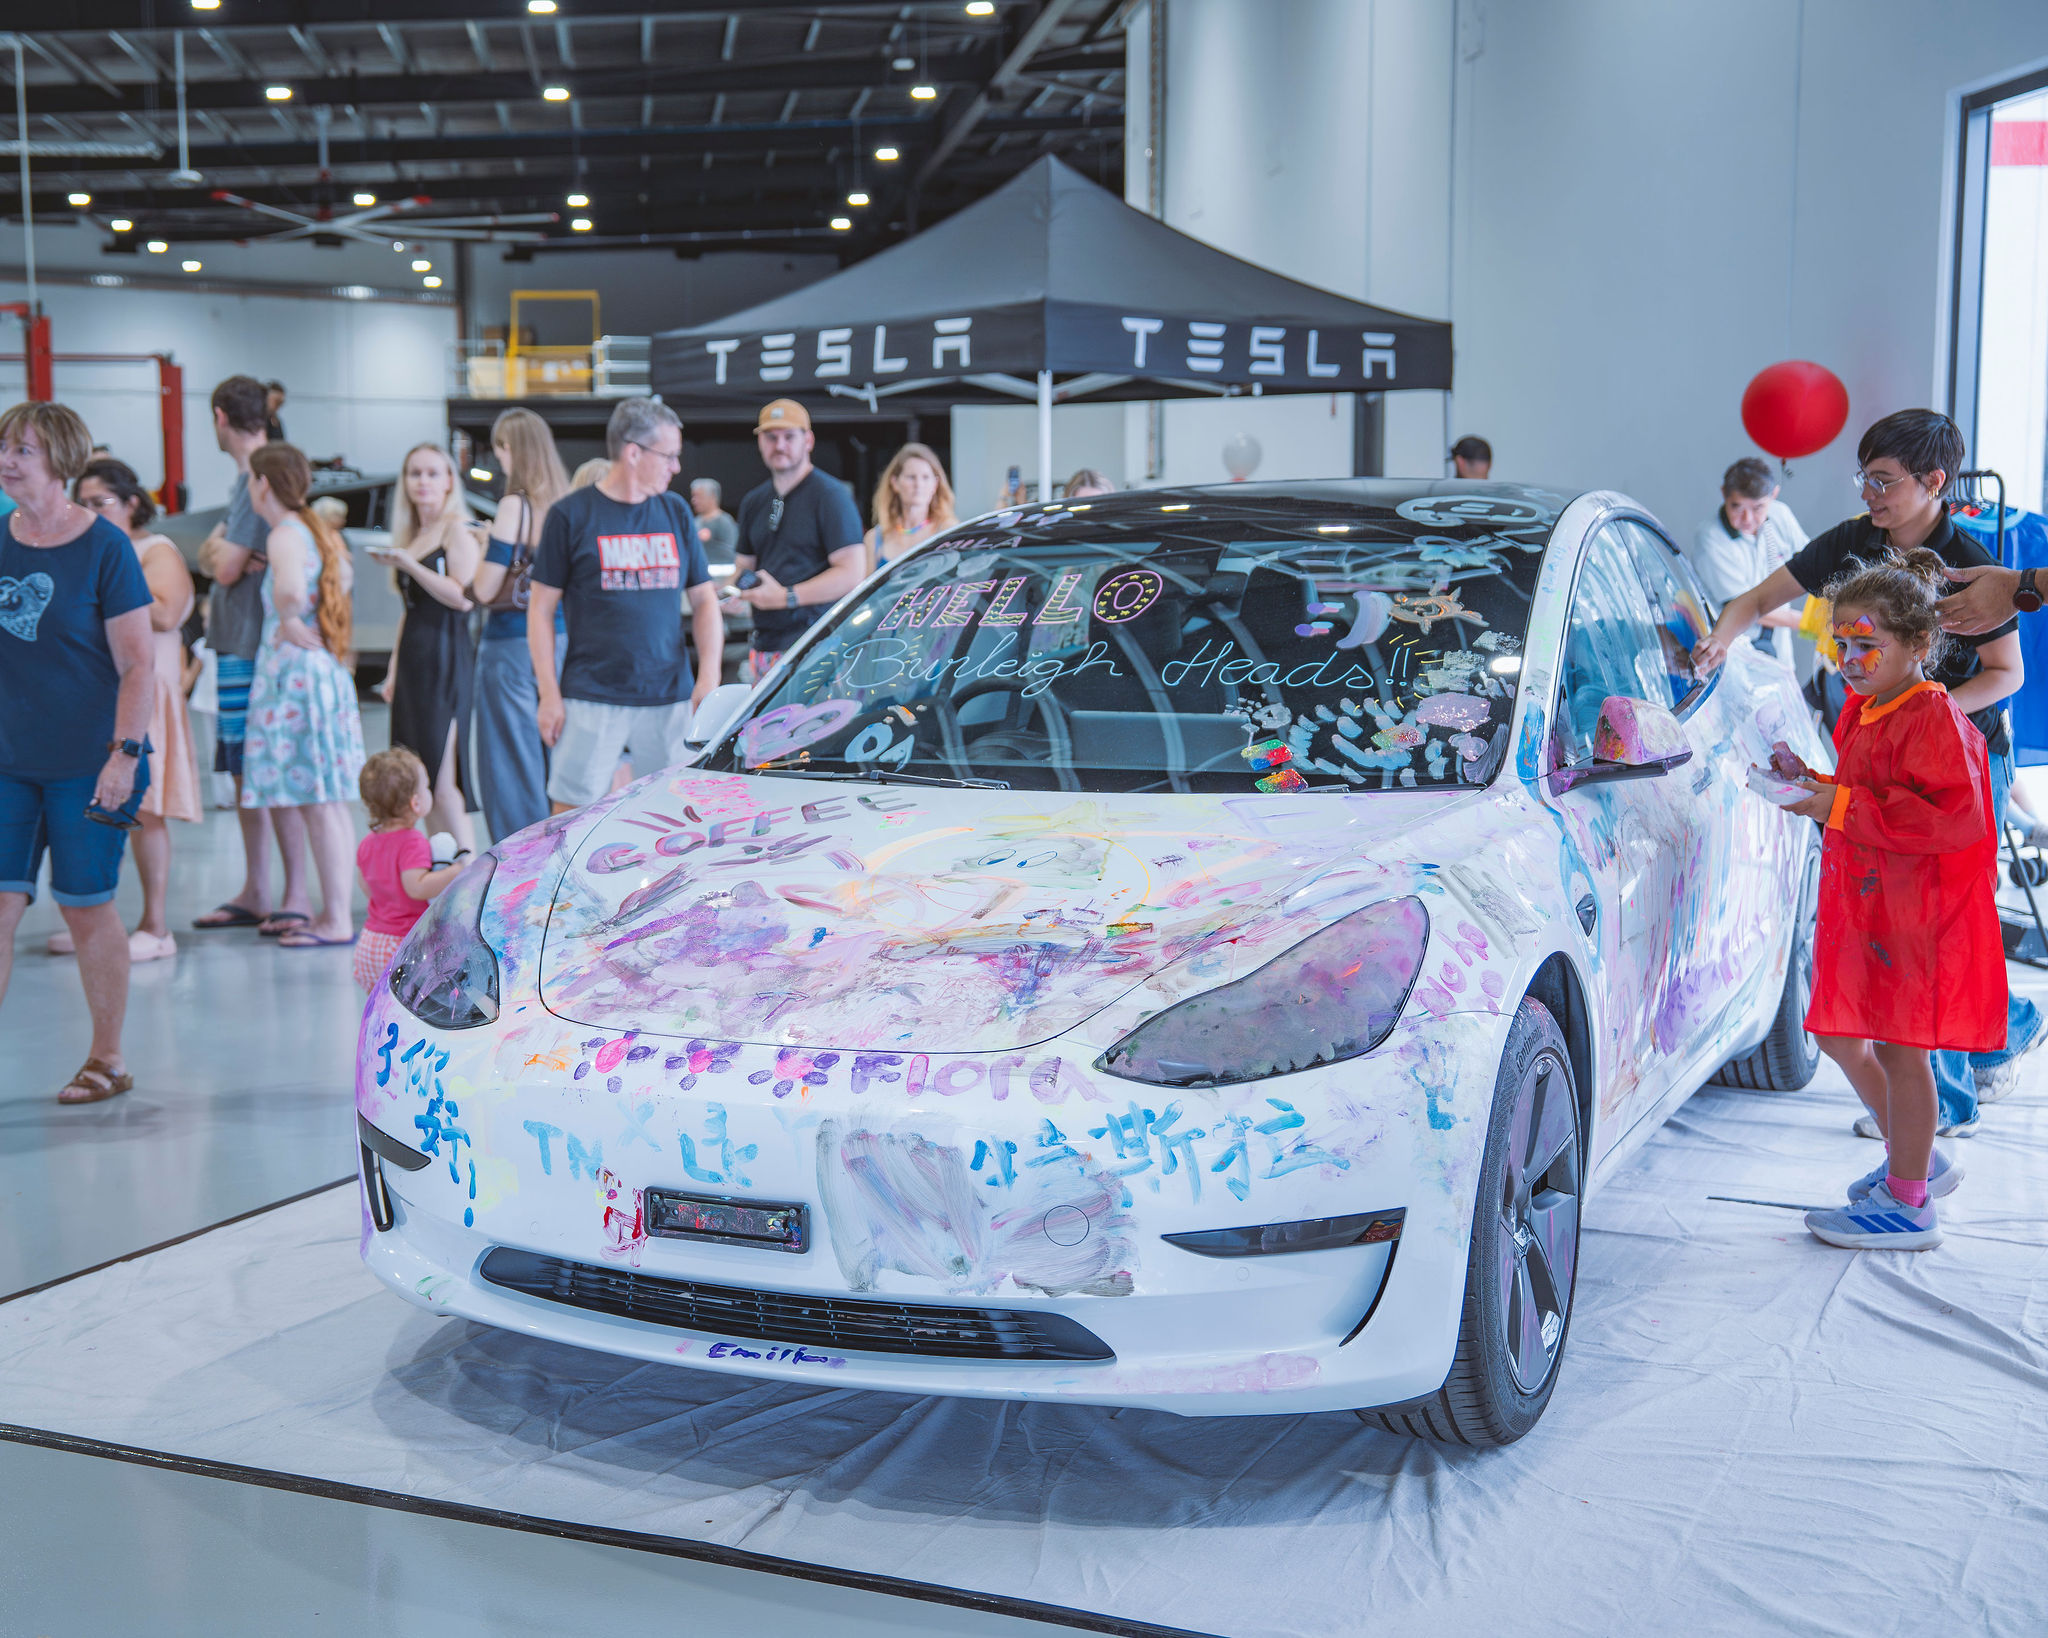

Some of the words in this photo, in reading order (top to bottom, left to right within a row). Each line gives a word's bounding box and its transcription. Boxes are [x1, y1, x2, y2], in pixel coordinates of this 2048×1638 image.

[705, 317, 973, 385] TESLA
[1121, 317, 1397, 380] TESLA
[600, 535, 678, 569] MARVEL
[877, 570, 1163, 631] HELLO
[838, 631, 1123, 698] Burleigh
[850, 1054, 1112, 1106] Flora
